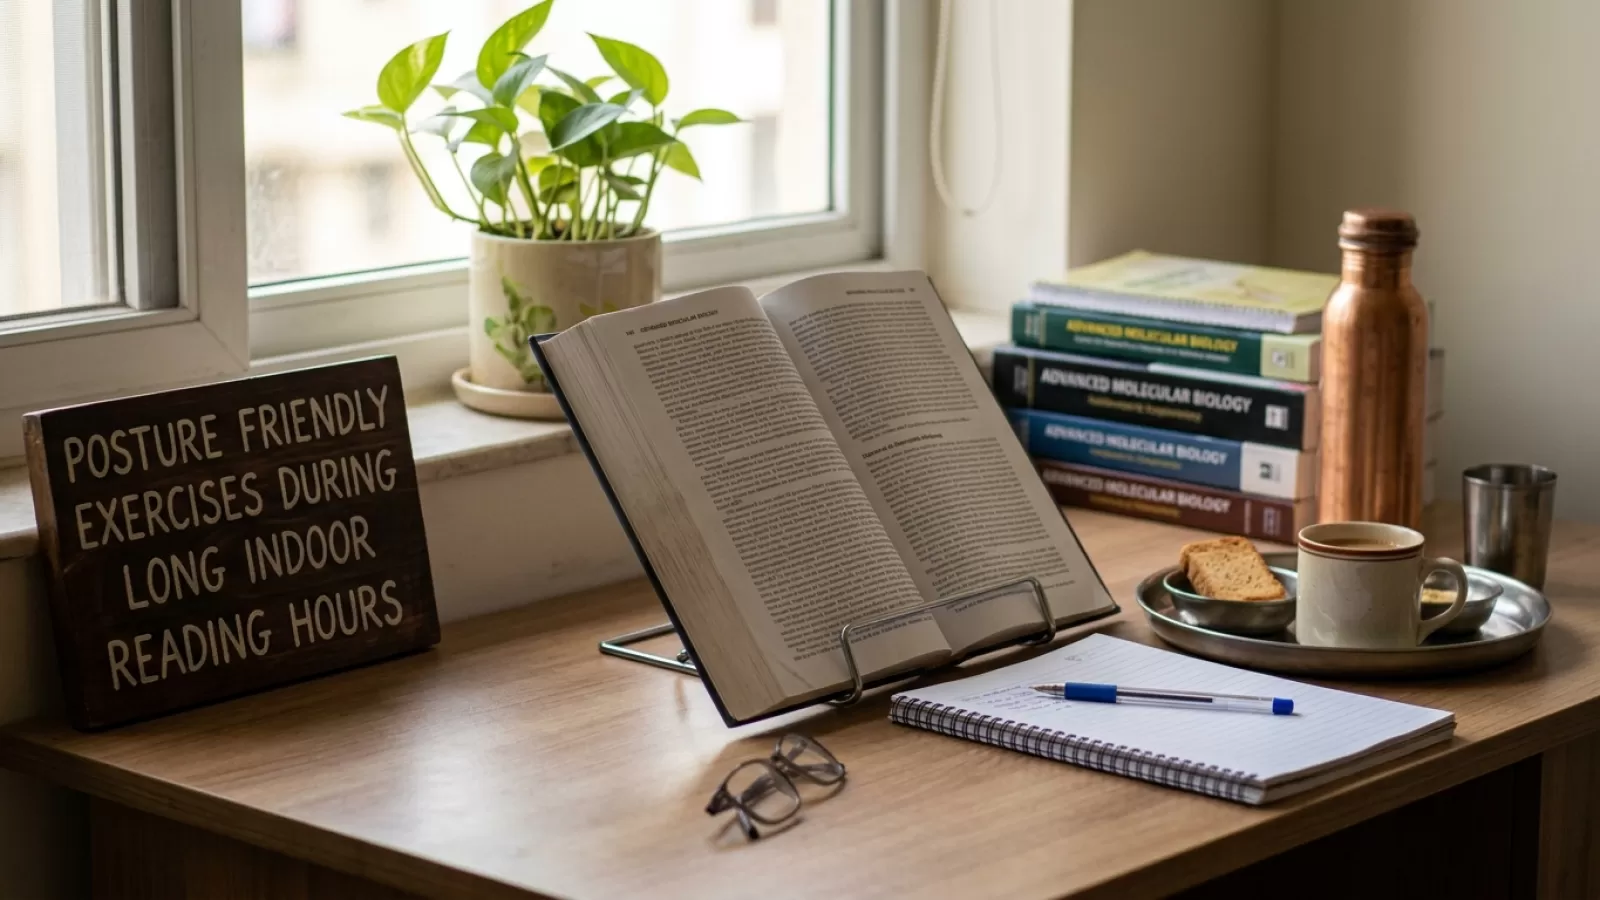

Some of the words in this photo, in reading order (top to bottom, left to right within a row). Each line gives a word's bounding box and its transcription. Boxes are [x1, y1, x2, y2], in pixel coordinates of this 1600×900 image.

[1124, 326, 1188, 347] MOLECULAR
[1190, 335, 1239, 353] BIOLOGY
[1040, 368, 1110, 393] ADVANCED
[1111, 378, 1192, 404] MOLECULAR
[1193, 389, 1252, 414] BIOLOGY
[63, 413, 223, 484] POSTURE
[238, 384, 389, 453] FRIENDLY
[1044, 423, 1105, 446] ADVANCED
[1106, 434, 1175, 458] MOLECULAR
[1177, 444, 1228, 466] BIOLOGY
[74, 471, 264, 551] EXERCISES
[278, 448, 398, 511] DURING
[1104, 479, 1175, 503] MOLECULAR
[1177, 491, 1231, 514] BIOLOGY
[123, 545, 227, 611] LONG
[244, 514, 377, 585] INDOOR
[107, 608, 272, 691] READING
[289, 579, 403, 648] HOURS
